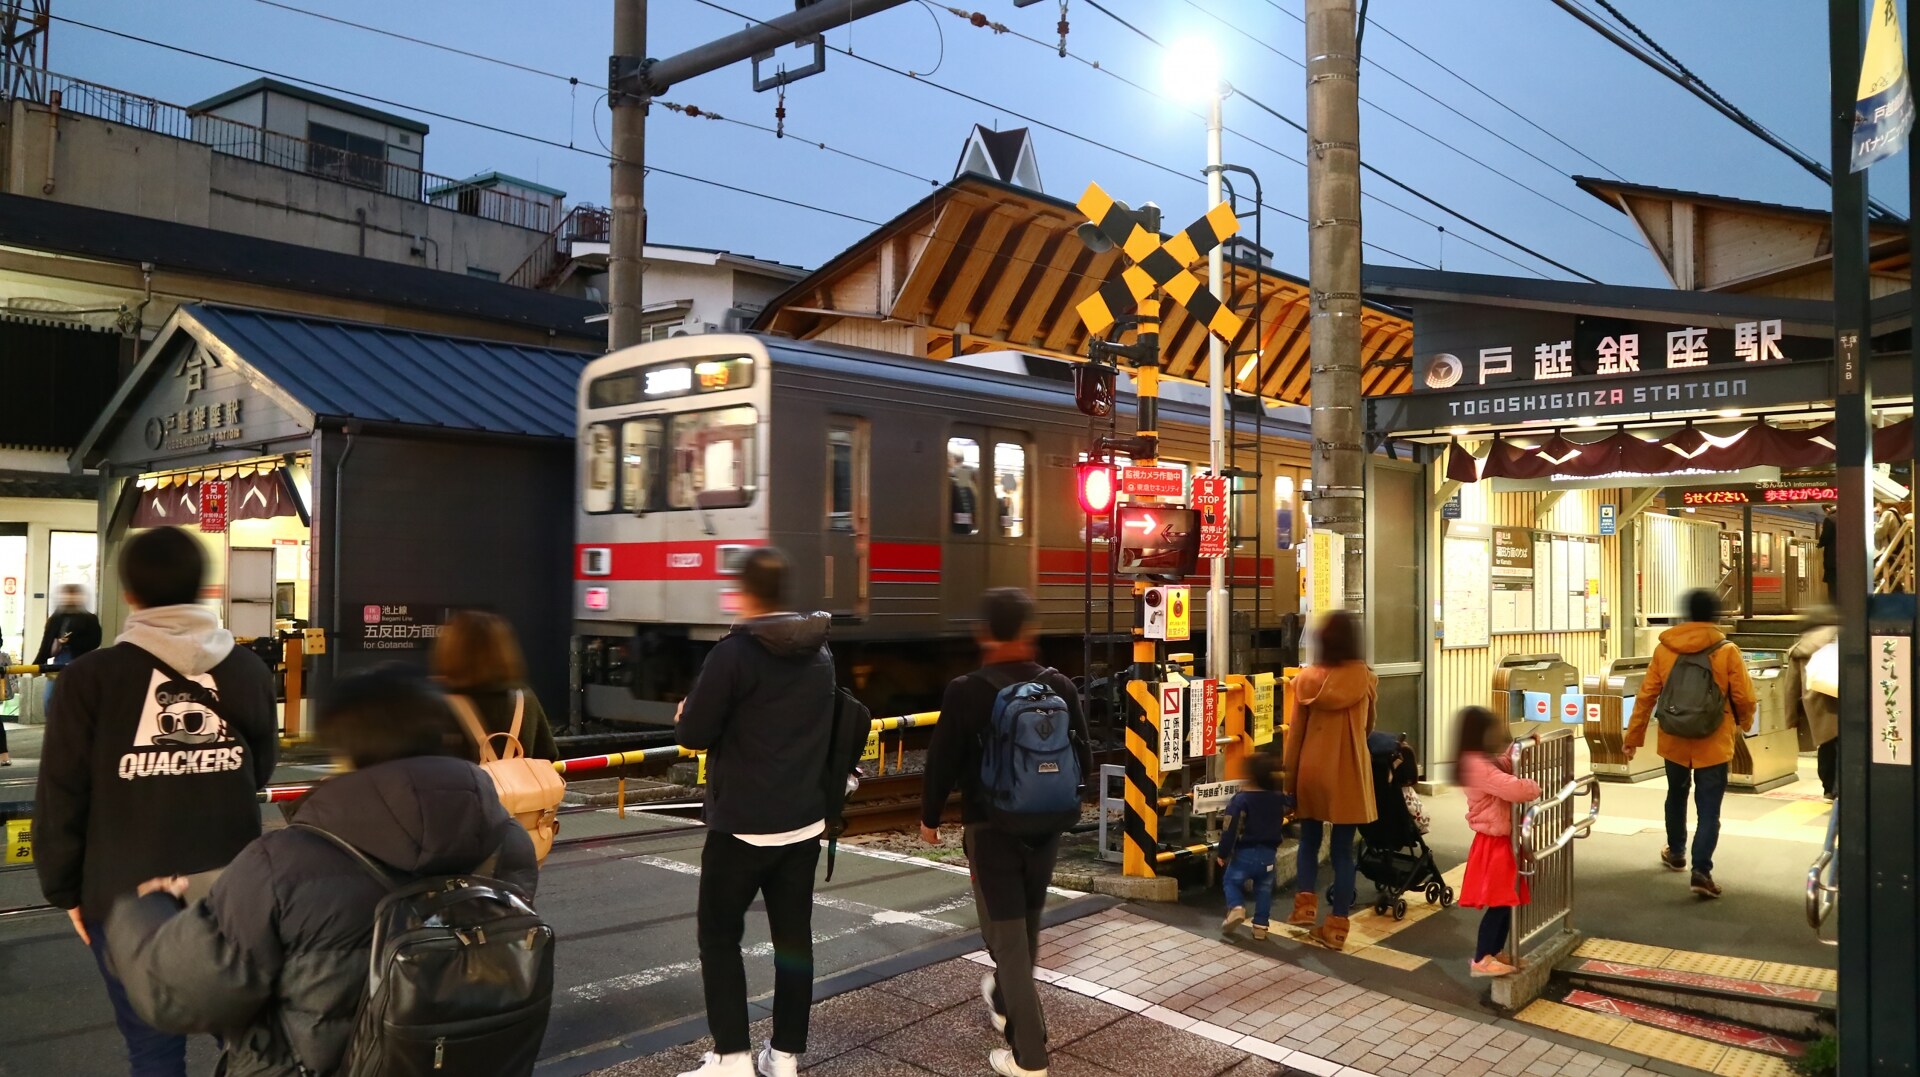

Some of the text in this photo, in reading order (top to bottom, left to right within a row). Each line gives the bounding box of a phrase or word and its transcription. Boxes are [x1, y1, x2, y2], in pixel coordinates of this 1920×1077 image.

[1479, 319, 1784, 385] 戸越銀座駅
[1449, 379, 1748, 417] TOGOSHIGINZA STATION
[164, 400, 241, 436] 戸越銀座駅
[1125, 469, 1181, 481] 監視カメラ作動中
[1197, 495, 1220, 504] STOP
[1200, 525, 1223, 534] 常停止
[381, 605, 408, 615] 池上線
[363, 640, 414, 649] for Gotanda
[1205, 684, 1215, 751] 非常ボタン
[1163, 718, 1171, 765] 立入禁止
[1172, 717, 1181, 764] 係員以外
[118, 745, 243, 781] QUACKERS
